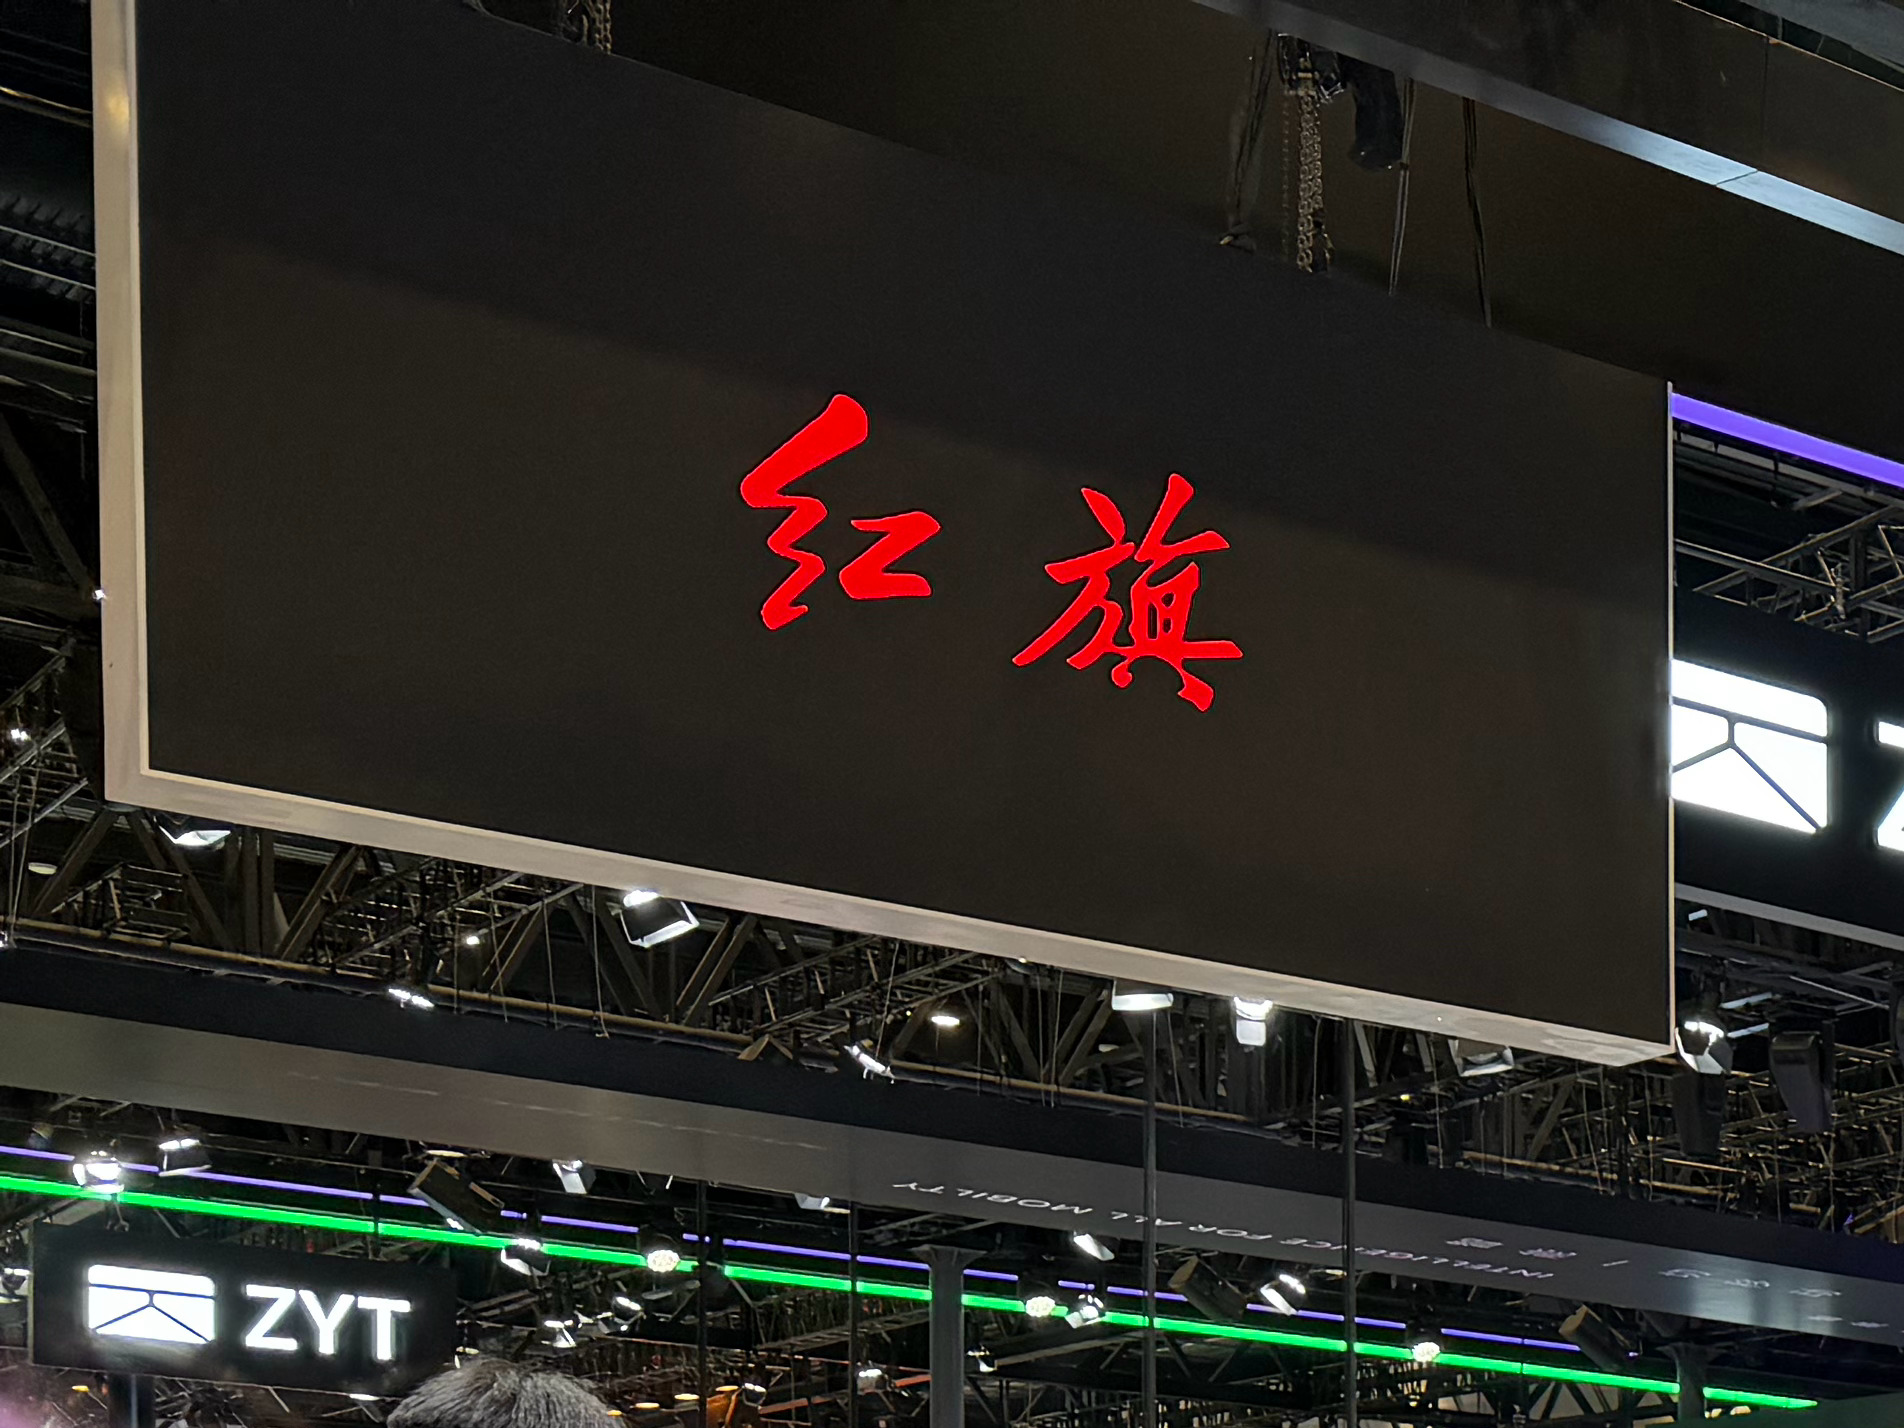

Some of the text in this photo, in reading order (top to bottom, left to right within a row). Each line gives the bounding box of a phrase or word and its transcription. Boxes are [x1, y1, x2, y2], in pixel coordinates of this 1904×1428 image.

[740, 394, 1243, 711] 红旗
[1189, 1223, 1273, 1241] FOR
[244, 1283, 412, 1361] ZYT
